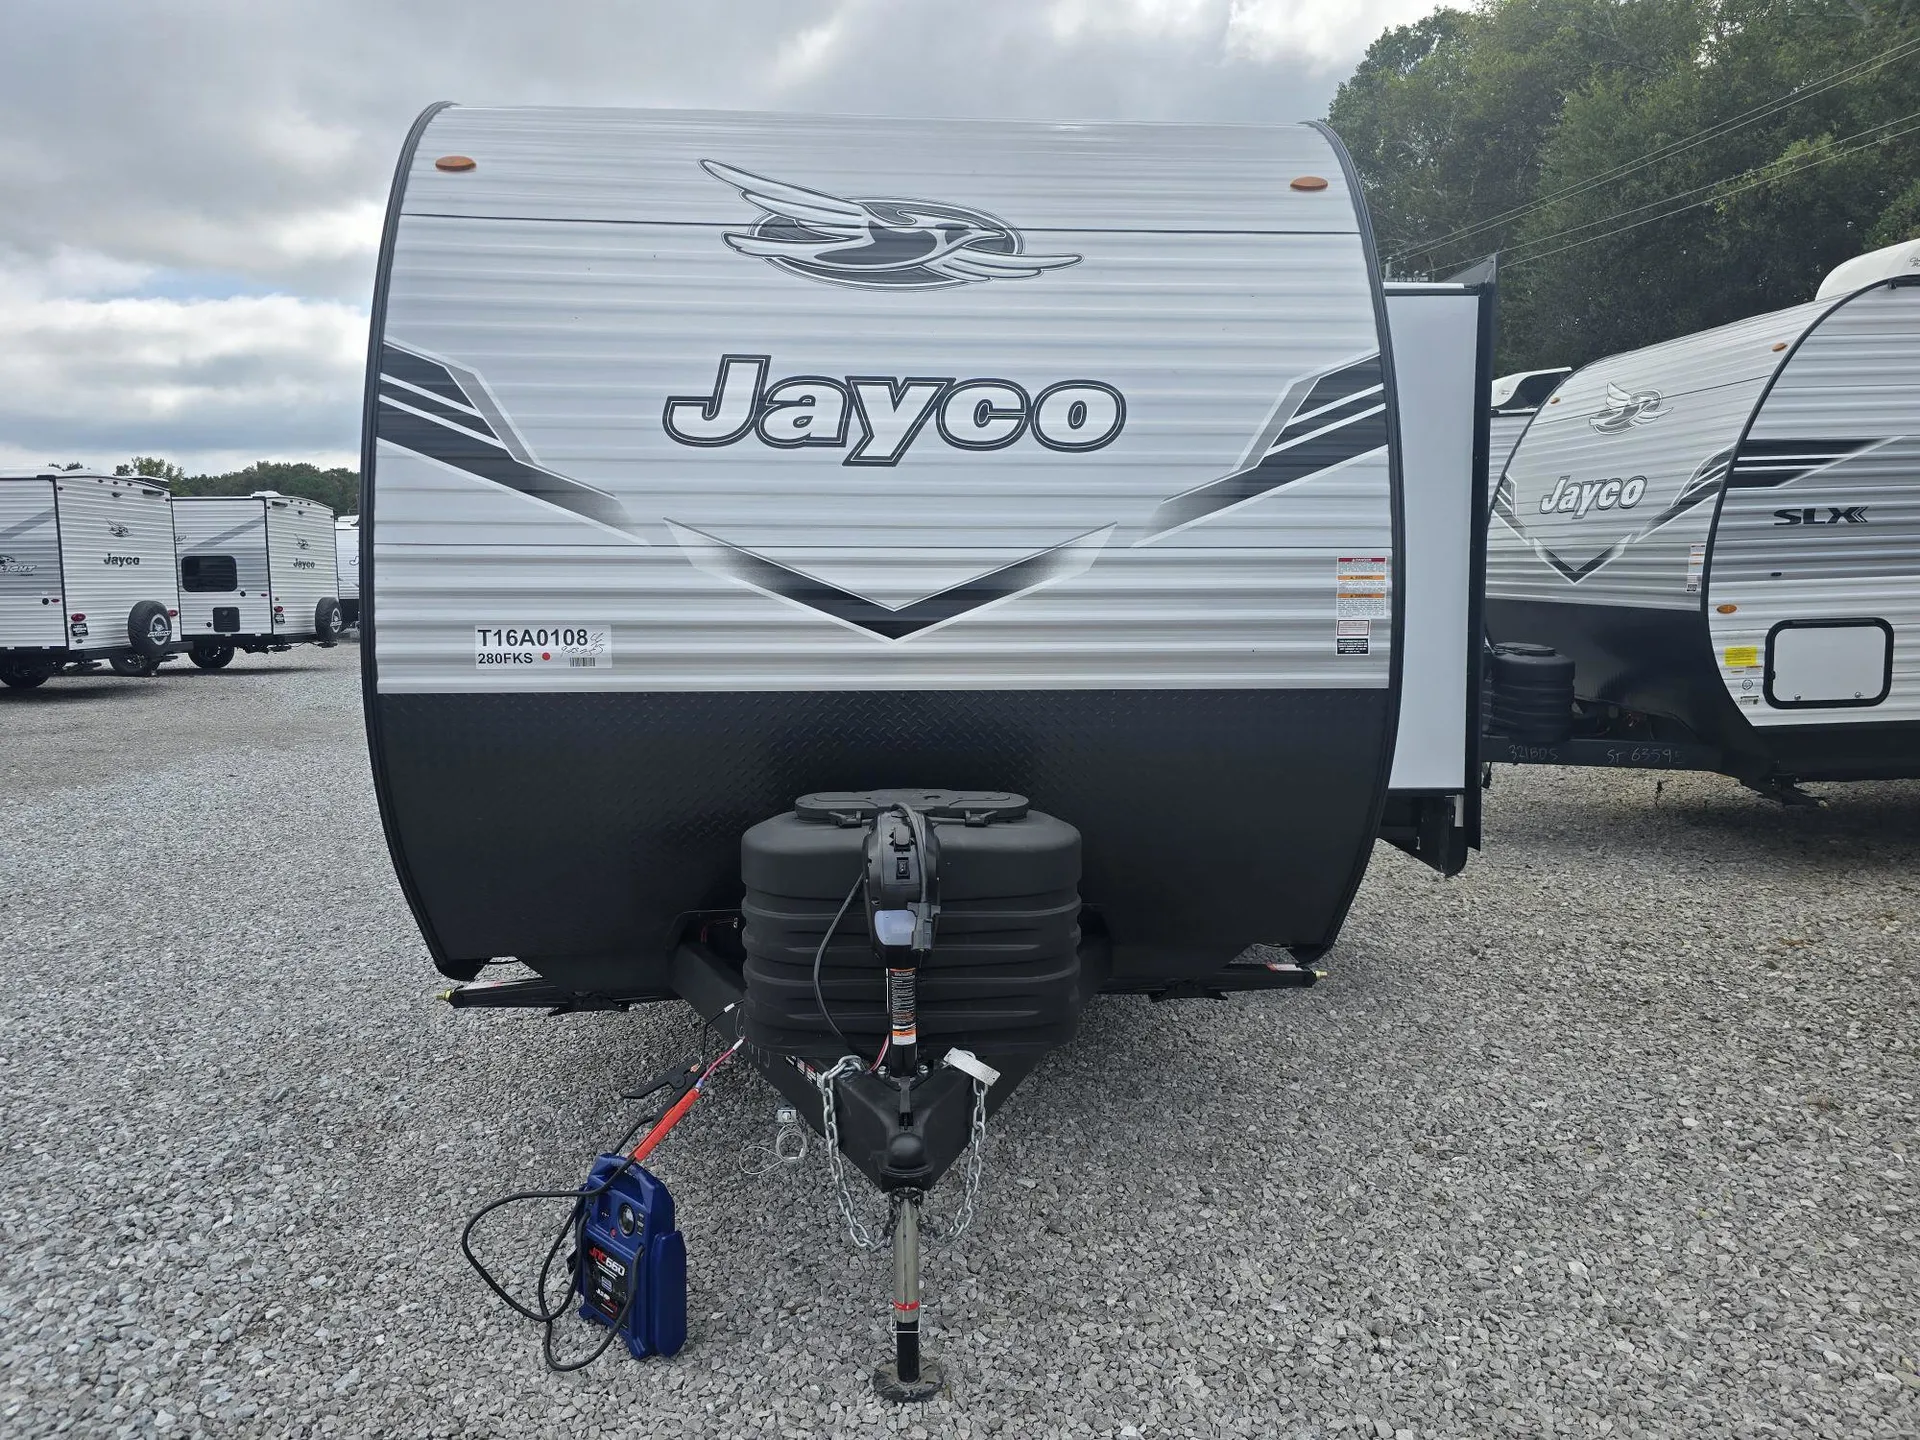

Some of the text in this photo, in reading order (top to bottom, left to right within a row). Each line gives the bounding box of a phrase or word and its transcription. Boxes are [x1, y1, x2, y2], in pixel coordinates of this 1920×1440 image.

[662, 354, 1127, 467] Jayco
[1539, 475, 1648, 520] Jayco
[1773, 506, 1869, 526] SLX
[103, 553, 141, 568] Jayco
[293, 557, 316, 571] Jayco
[477, 628, 589, 647] T16A0108
[477, 652, 534, 665] 280FKS
